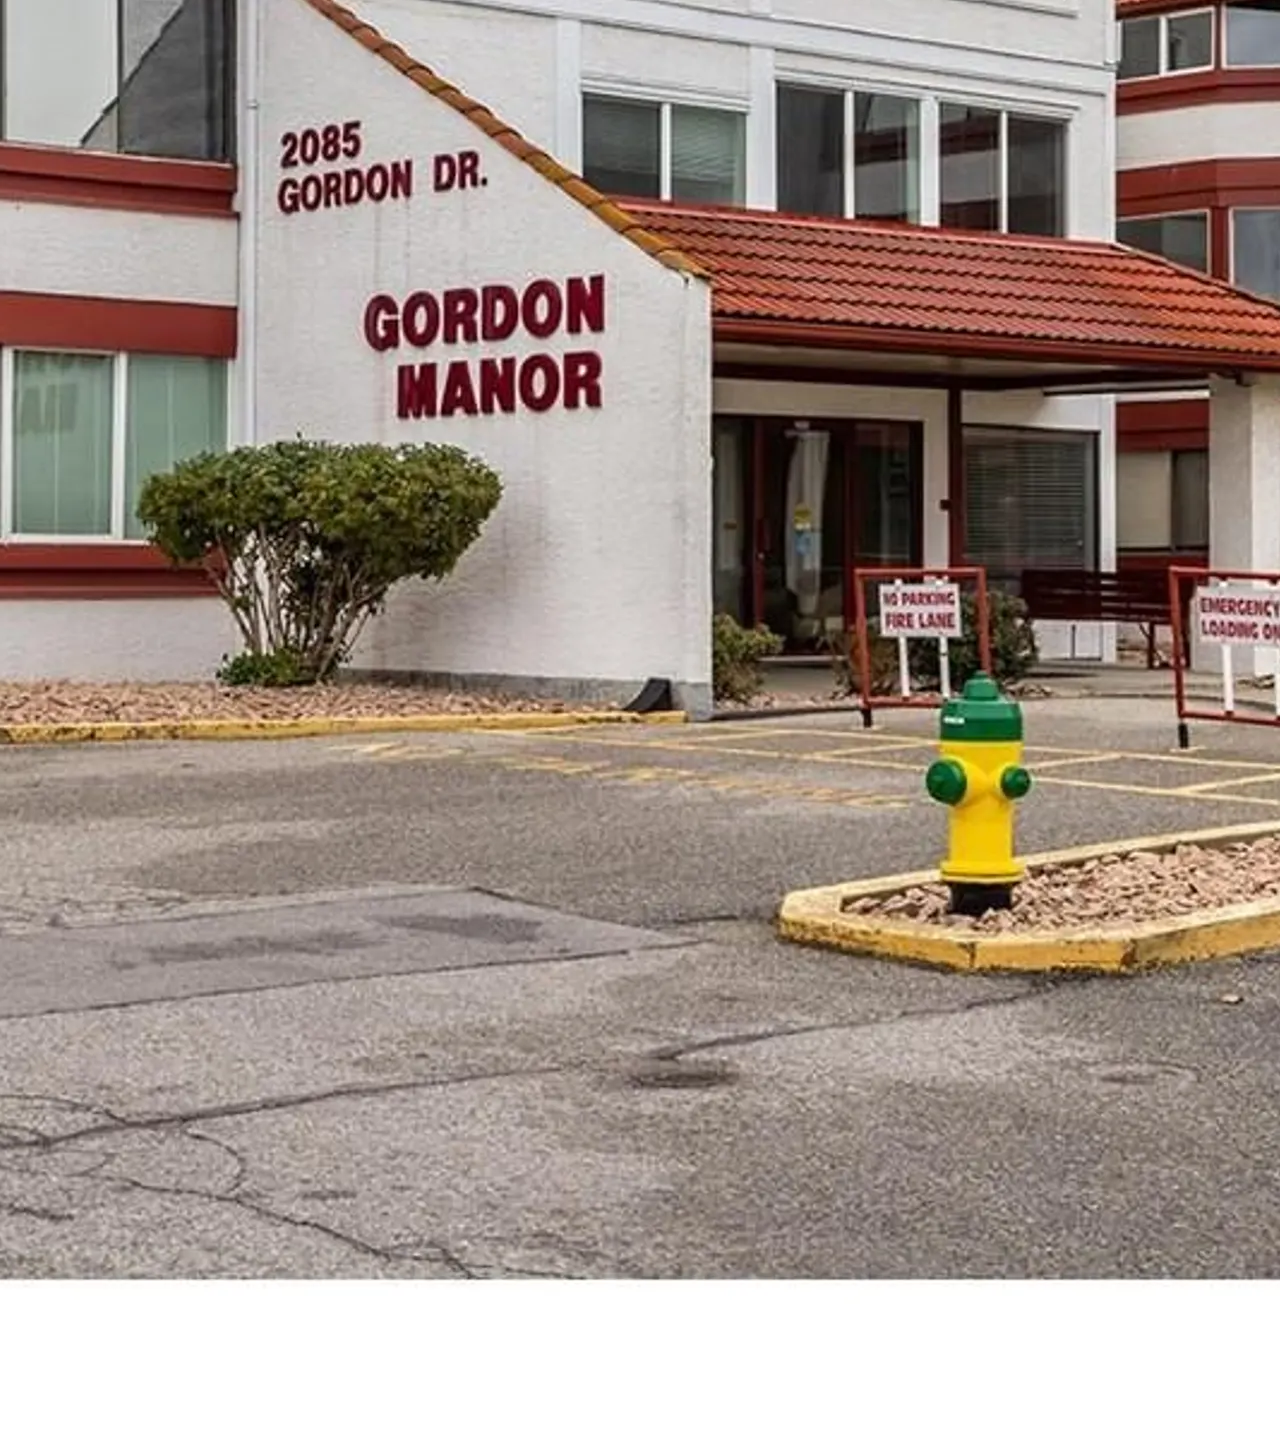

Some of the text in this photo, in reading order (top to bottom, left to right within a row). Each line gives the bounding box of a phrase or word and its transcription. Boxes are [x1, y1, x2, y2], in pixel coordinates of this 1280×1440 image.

[281, 121, 361, 169] 2085
[278, 151, 488, 215] GORDON DR.
[363, 274, 605, 353] GORDON
[396, 350, 602, 420] MANOR
[883, 592, 956, 606] NO PARKING
[1200, 597, 1280, 618] EMERGENCY
[885, 612, 956, 629] FIRE LANE
[1201, 620, 1259, 639] LOADING
